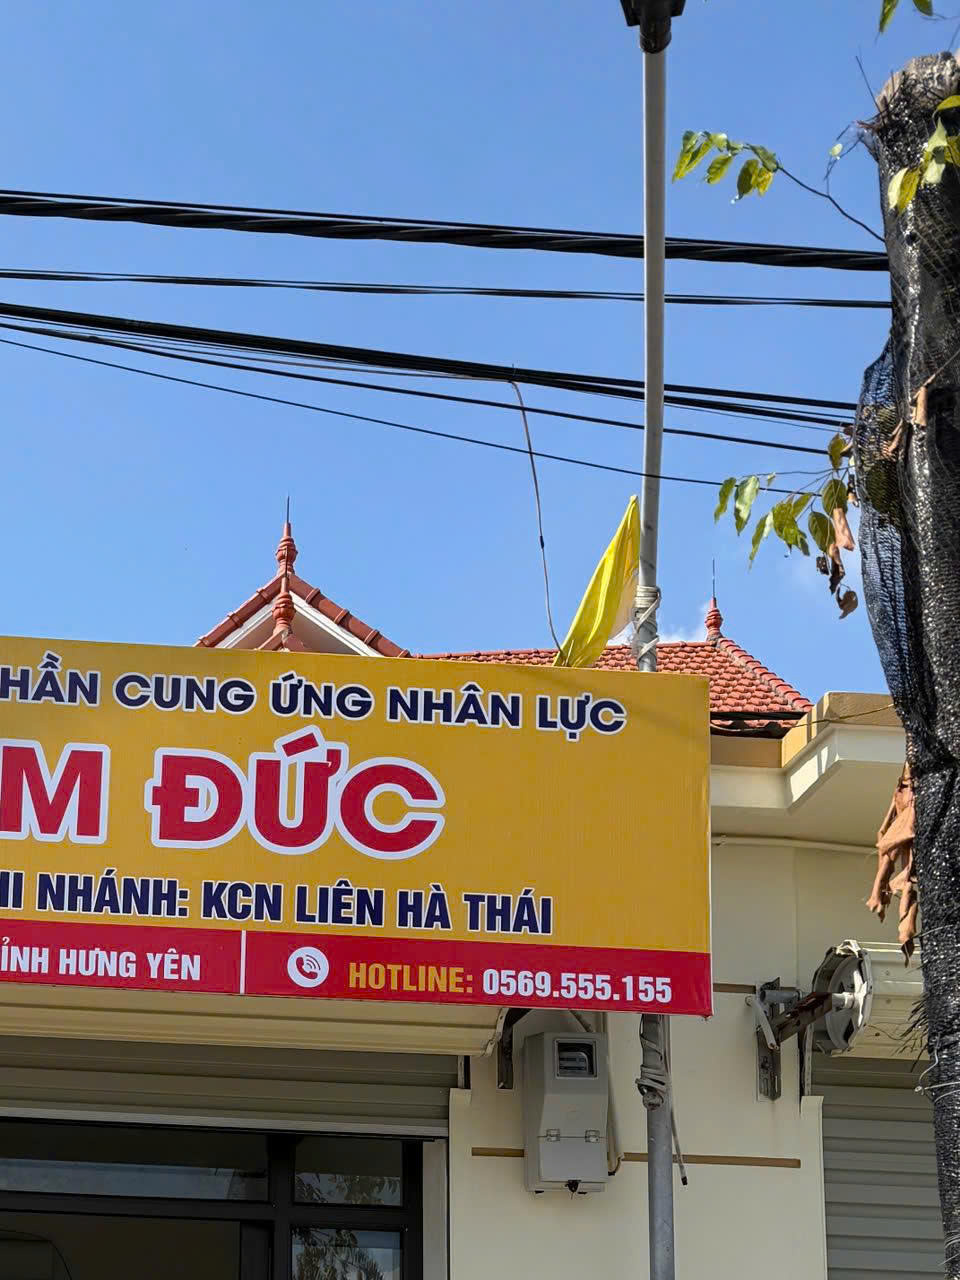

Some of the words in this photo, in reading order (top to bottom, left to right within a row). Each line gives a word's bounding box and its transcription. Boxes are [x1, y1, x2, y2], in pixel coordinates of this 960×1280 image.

[115, 672, 256, 715] CUNG
[270, 671, 374, 721] ỨNG
[388, 682, 523, 730] NHÂN
[536, 692, 627, 742] LỰC
[145, 725, 445, 860] ĐỨC
[36, 868, 189, 918] NHÁNH:
[201, 879, 283, 924] KCN
[297, 878, 385, 928] LIÊN
[397, 882, 451, 932] HÀ
[463, 887, 553, 936] THÁI
[58, 946, 137, 978] HƯNG
[145, 947, 201, 982] YÊN
[348, 962, 474, 994] HOTLINE:
[482, 968, 673, 1003] 0569.555.155
